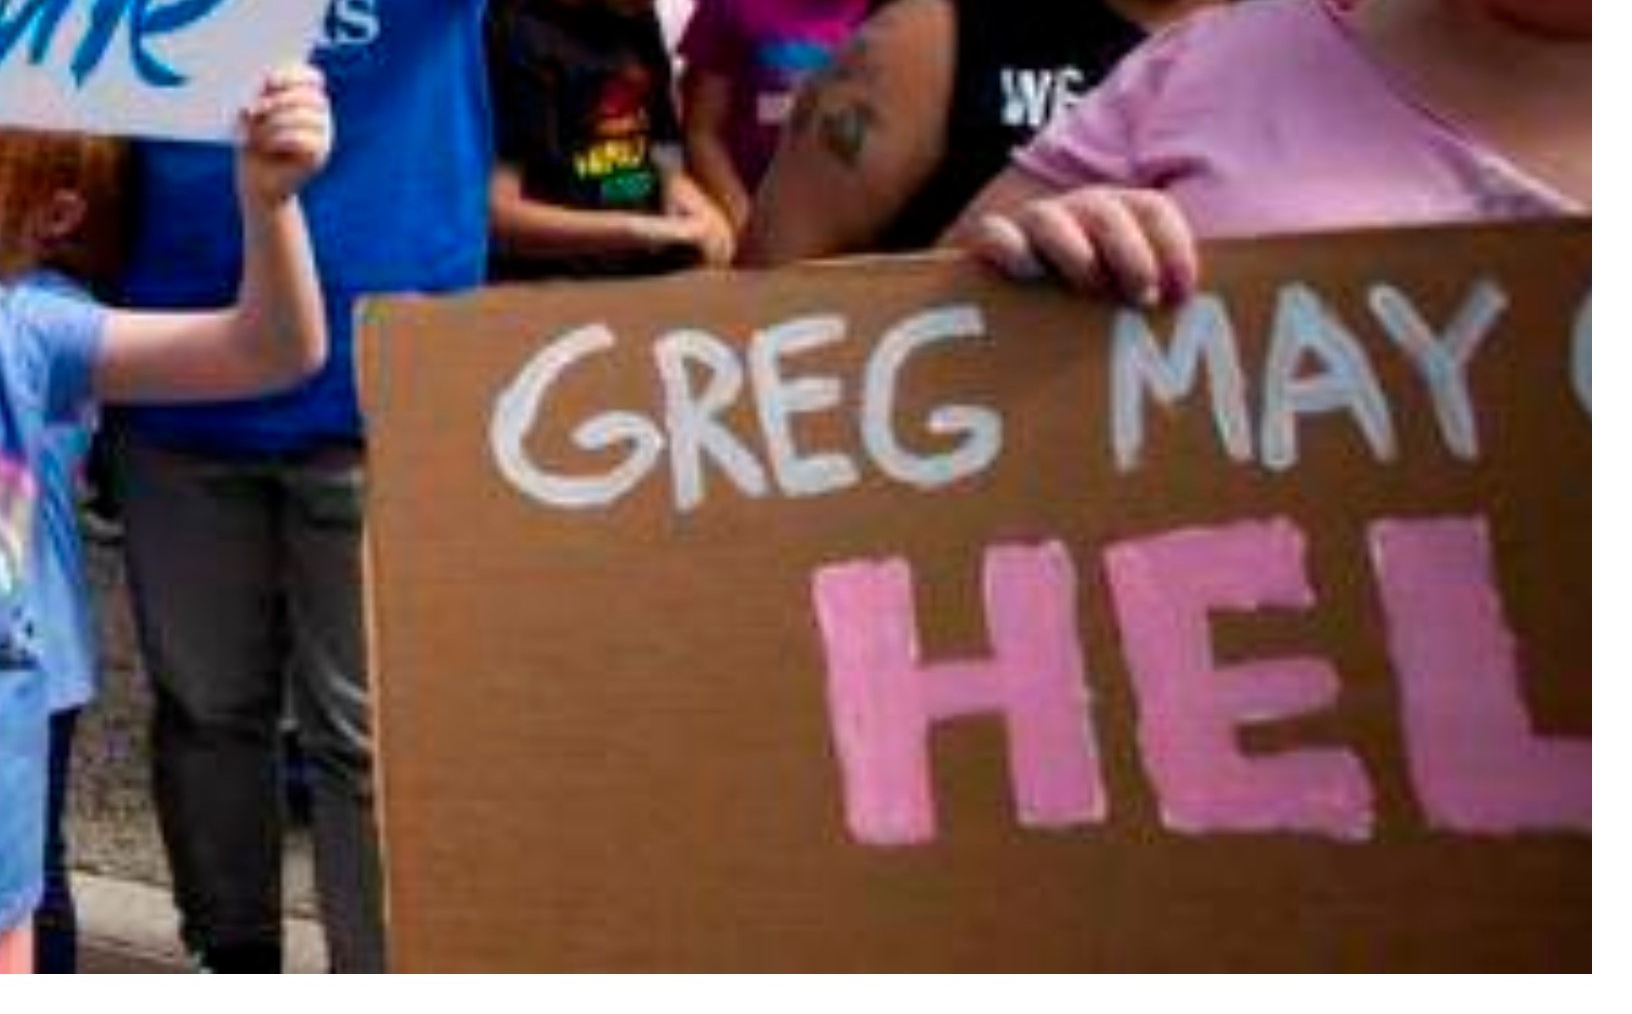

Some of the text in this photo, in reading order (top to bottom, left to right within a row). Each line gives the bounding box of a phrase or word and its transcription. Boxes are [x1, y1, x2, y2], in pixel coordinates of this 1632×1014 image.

[488, 304, 1002, 512] GREG
[1111, 279, 1509, 474] MAY
[811, 515, 1592, 845] HEL
